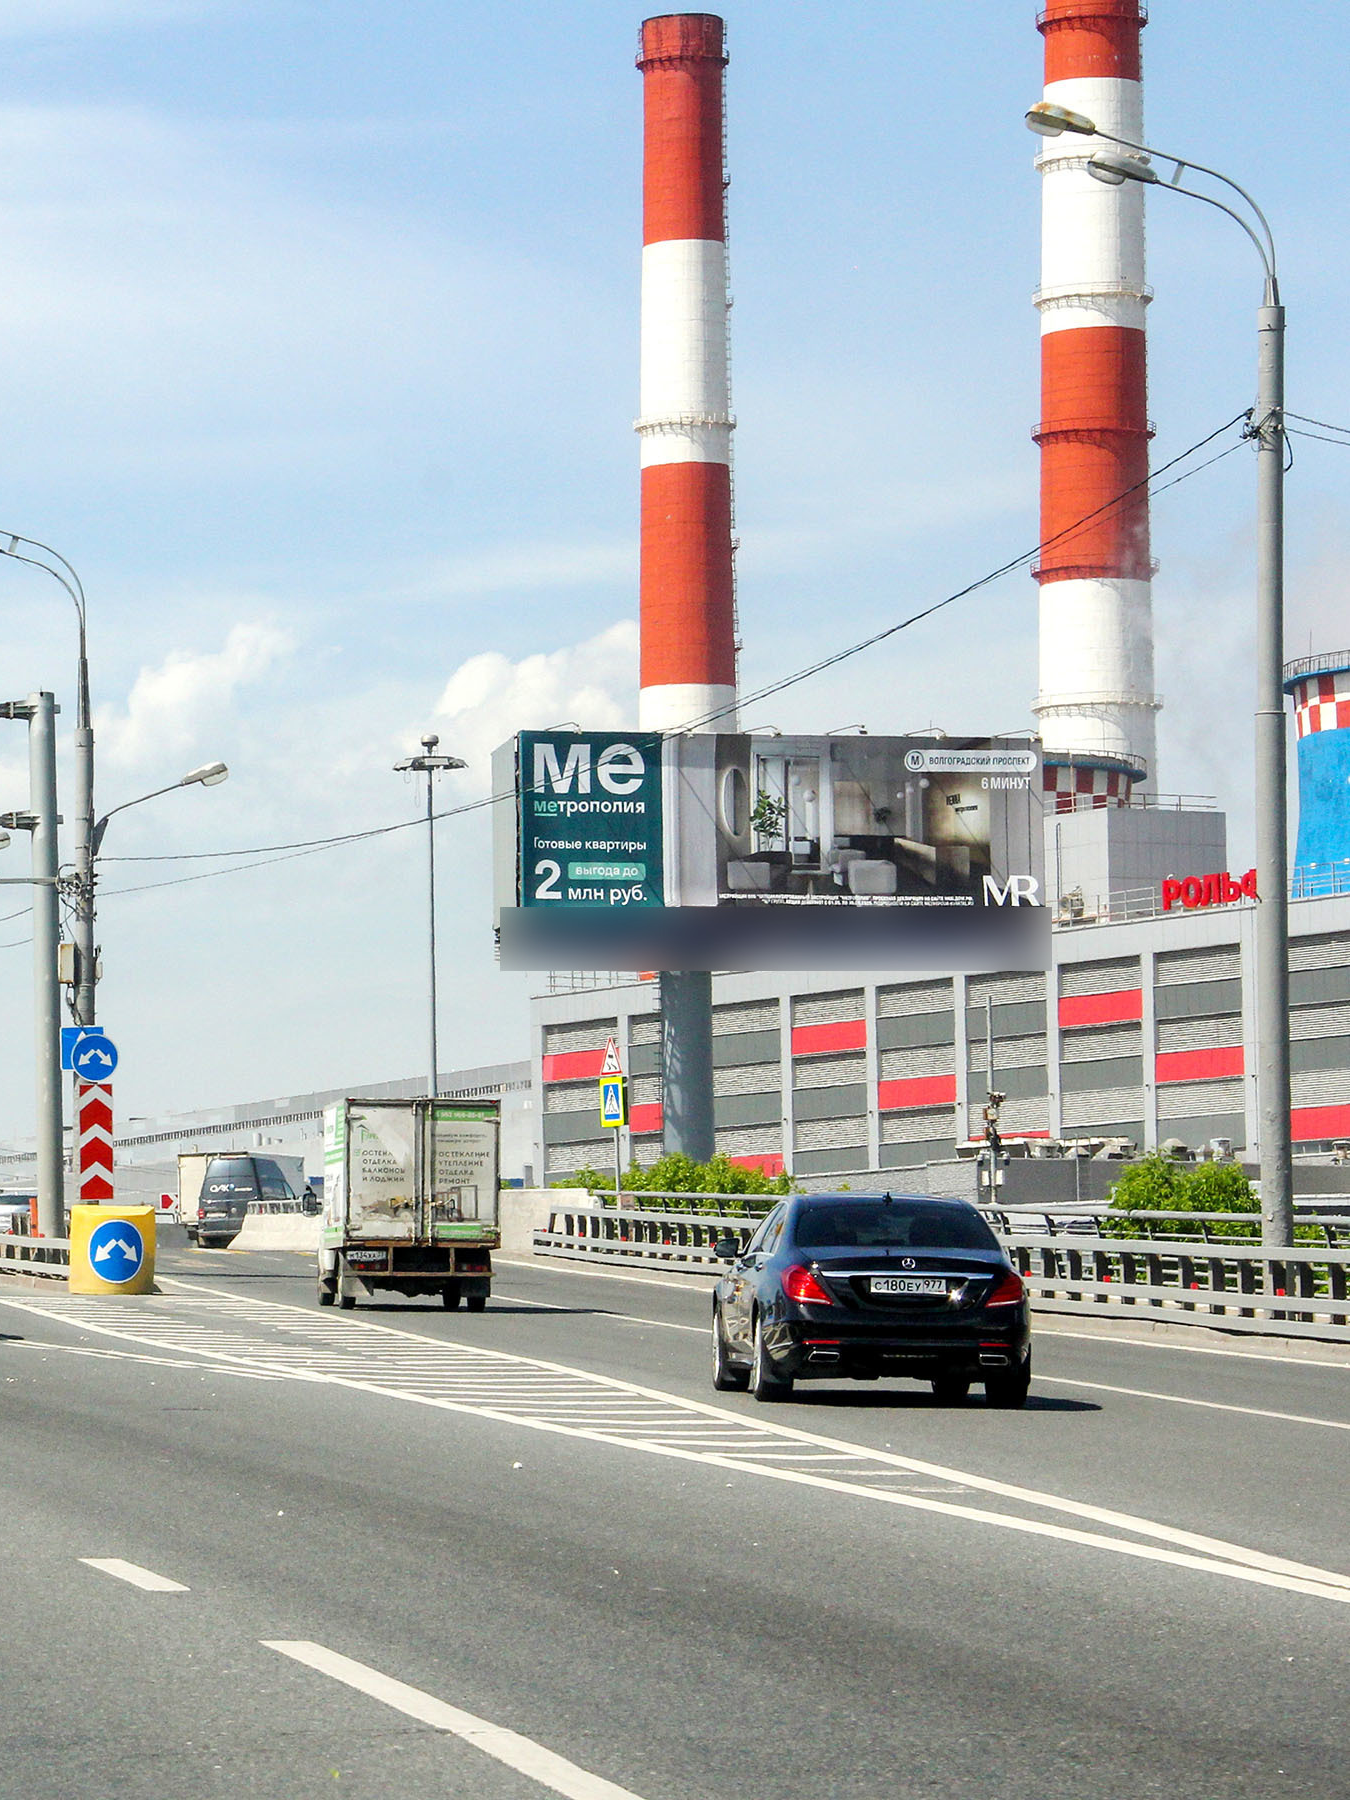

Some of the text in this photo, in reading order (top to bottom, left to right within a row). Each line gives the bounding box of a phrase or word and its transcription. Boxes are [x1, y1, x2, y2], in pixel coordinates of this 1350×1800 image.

[929, 755, 991, 766] ВОЛГОГРАДСКИЙ
[993, 757, 1030, 765] ПРОСПЕКТ
[981, 777, 1031, 790] 6 МИНУТ
[534, 800, 646, 817] метрополия
[533, 836, 647, 853] Готовые квартиры
[535, 859, 562, 900] 2
[575, 866, 639, 878] выгода до
[568, 884, 648, 905] млн руб.
[982, 875, 1039, 907] MR
